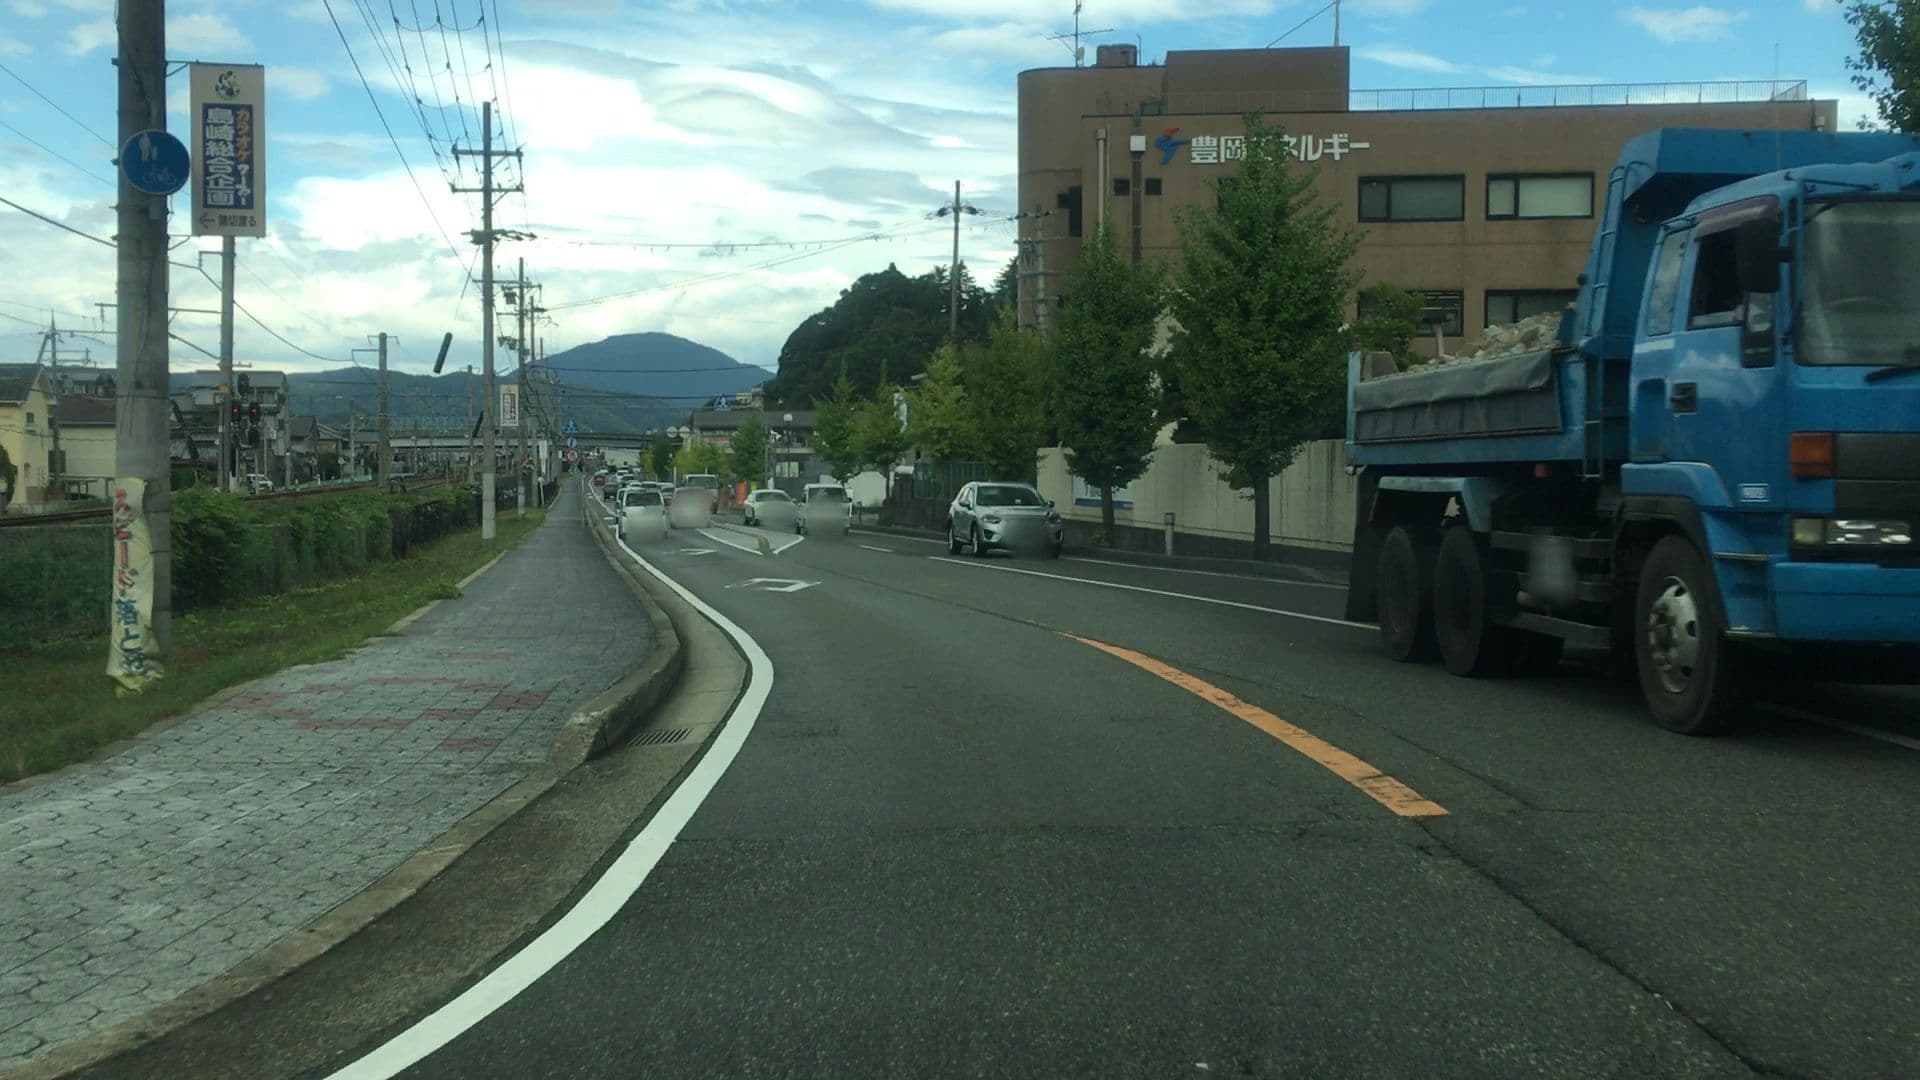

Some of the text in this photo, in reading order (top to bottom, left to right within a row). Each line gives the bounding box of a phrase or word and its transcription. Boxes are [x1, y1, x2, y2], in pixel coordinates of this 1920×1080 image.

[1191, 133, 1370, 163] 豊岡ネルギー
